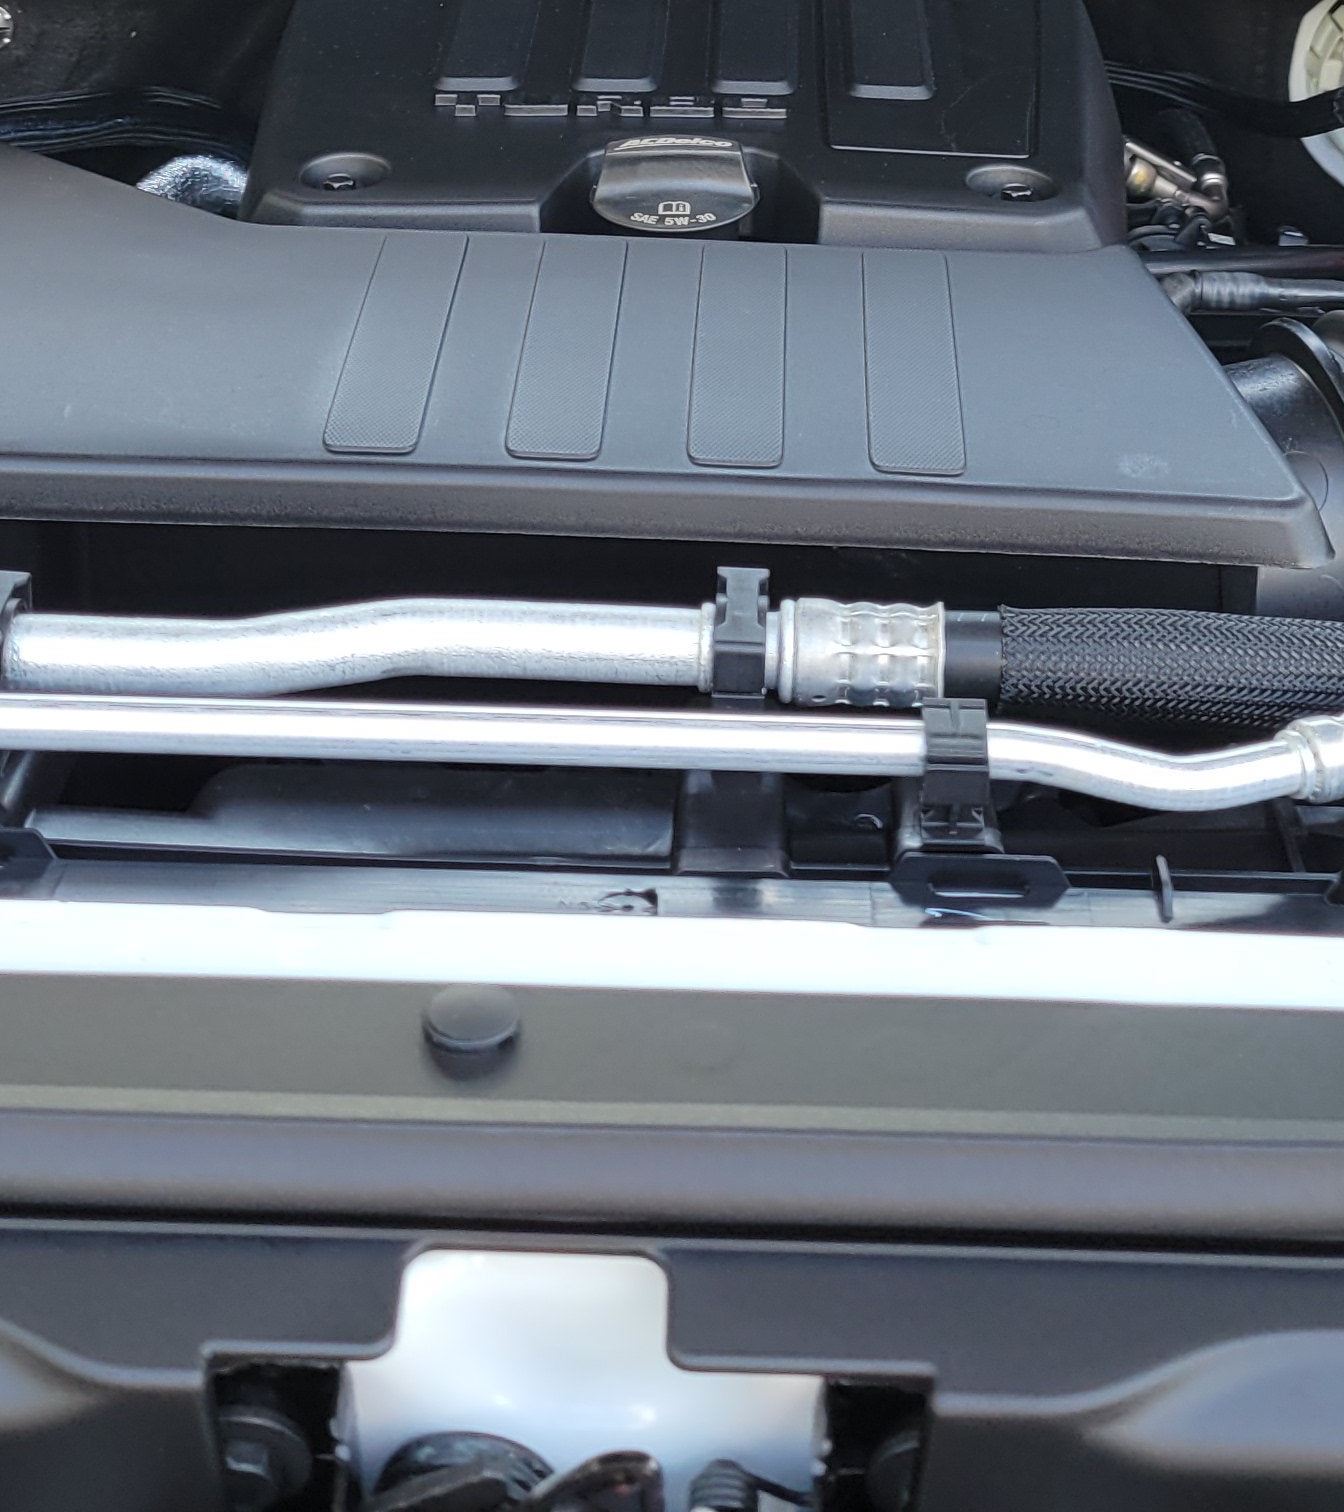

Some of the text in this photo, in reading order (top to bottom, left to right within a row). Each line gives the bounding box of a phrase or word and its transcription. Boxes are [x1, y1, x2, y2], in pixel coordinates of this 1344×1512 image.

[613, 137, 733, 151] ACDelco
[630, 212, 717, 226] SAE 5W-30
